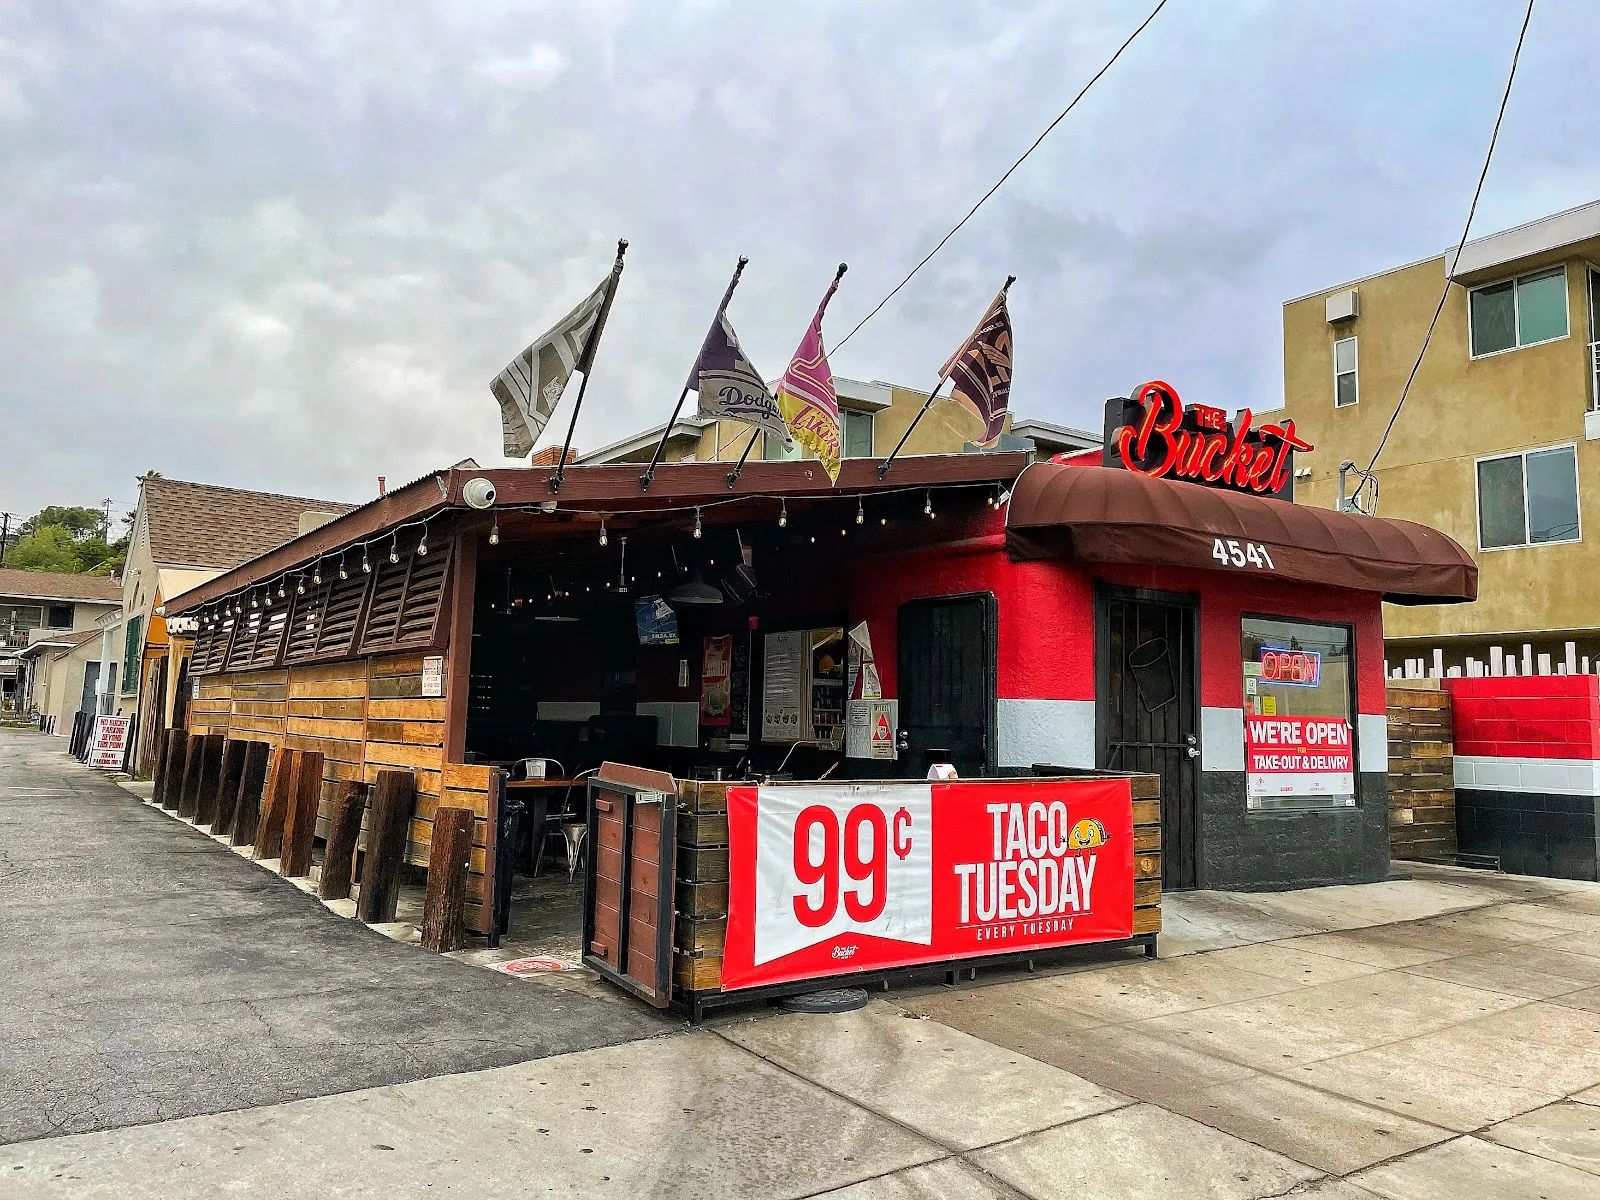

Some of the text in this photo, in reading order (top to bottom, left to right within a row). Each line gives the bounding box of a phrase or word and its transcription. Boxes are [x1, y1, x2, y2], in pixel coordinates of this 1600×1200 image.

[1194, 404, 1227, 432] THE
[1118, 380, 1314, 494] Bucket
[1212, 538, 1275, 570] 4541
[1262, 651, 1317, 683] OPEN
[1249, 720, 1348, 745] WE'RE OPEN
[1253, 755, 1301, 770] TAKE-OUT
[1302, 756, 1311, 769] &
[1297, 746, 1307, 754] FOR
[986, 800, 1068, 862] TACO
[954, 855, 1097, 923] TUESDAY
[976, 918, 1075, 941] EVERY TUESDAY
